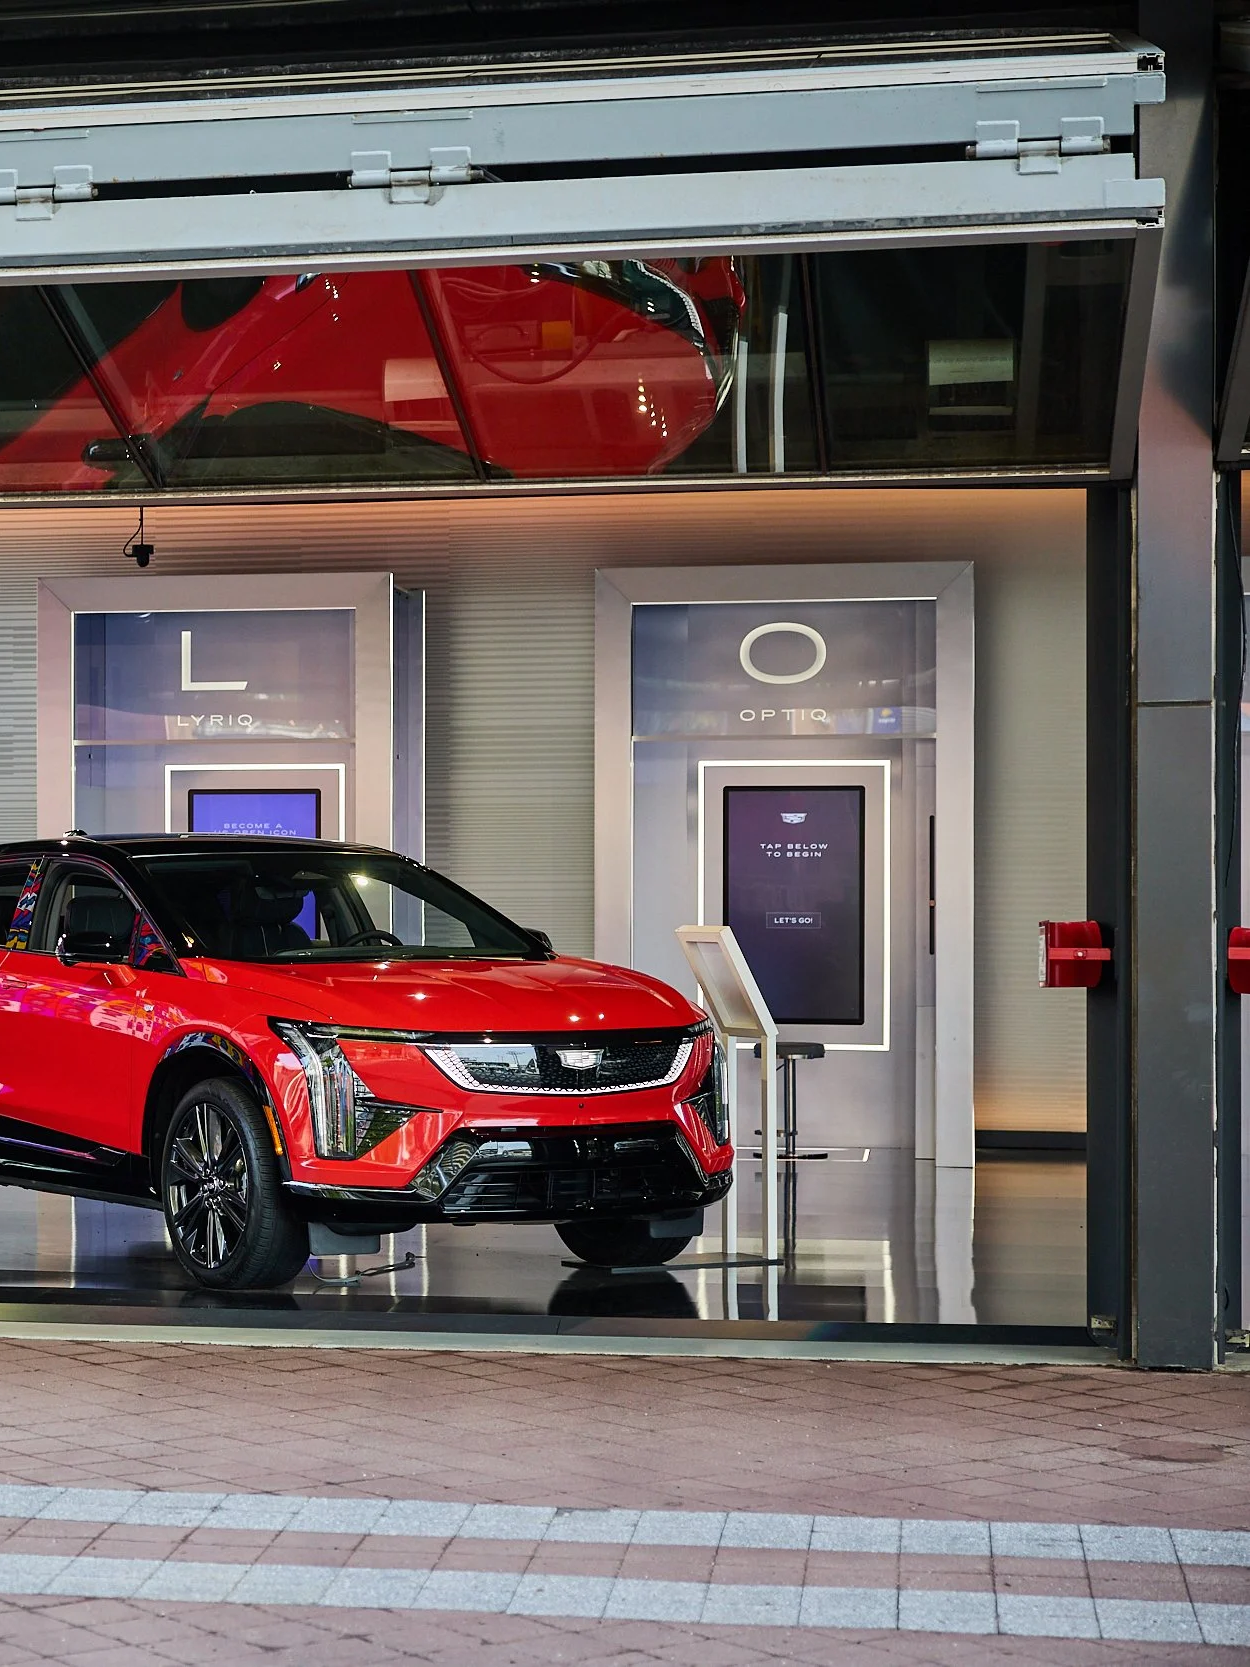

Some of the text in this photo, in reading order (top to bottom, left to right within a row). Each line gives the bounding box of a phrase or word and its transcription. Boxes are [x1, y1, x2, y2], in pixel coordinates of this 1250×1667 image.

[181, 630, 248, 691] L
[739, 621, 827, 685] O
[177, 714, 253, 728] LYRIQ
[739, 708, 827, 722] OPTIQ
